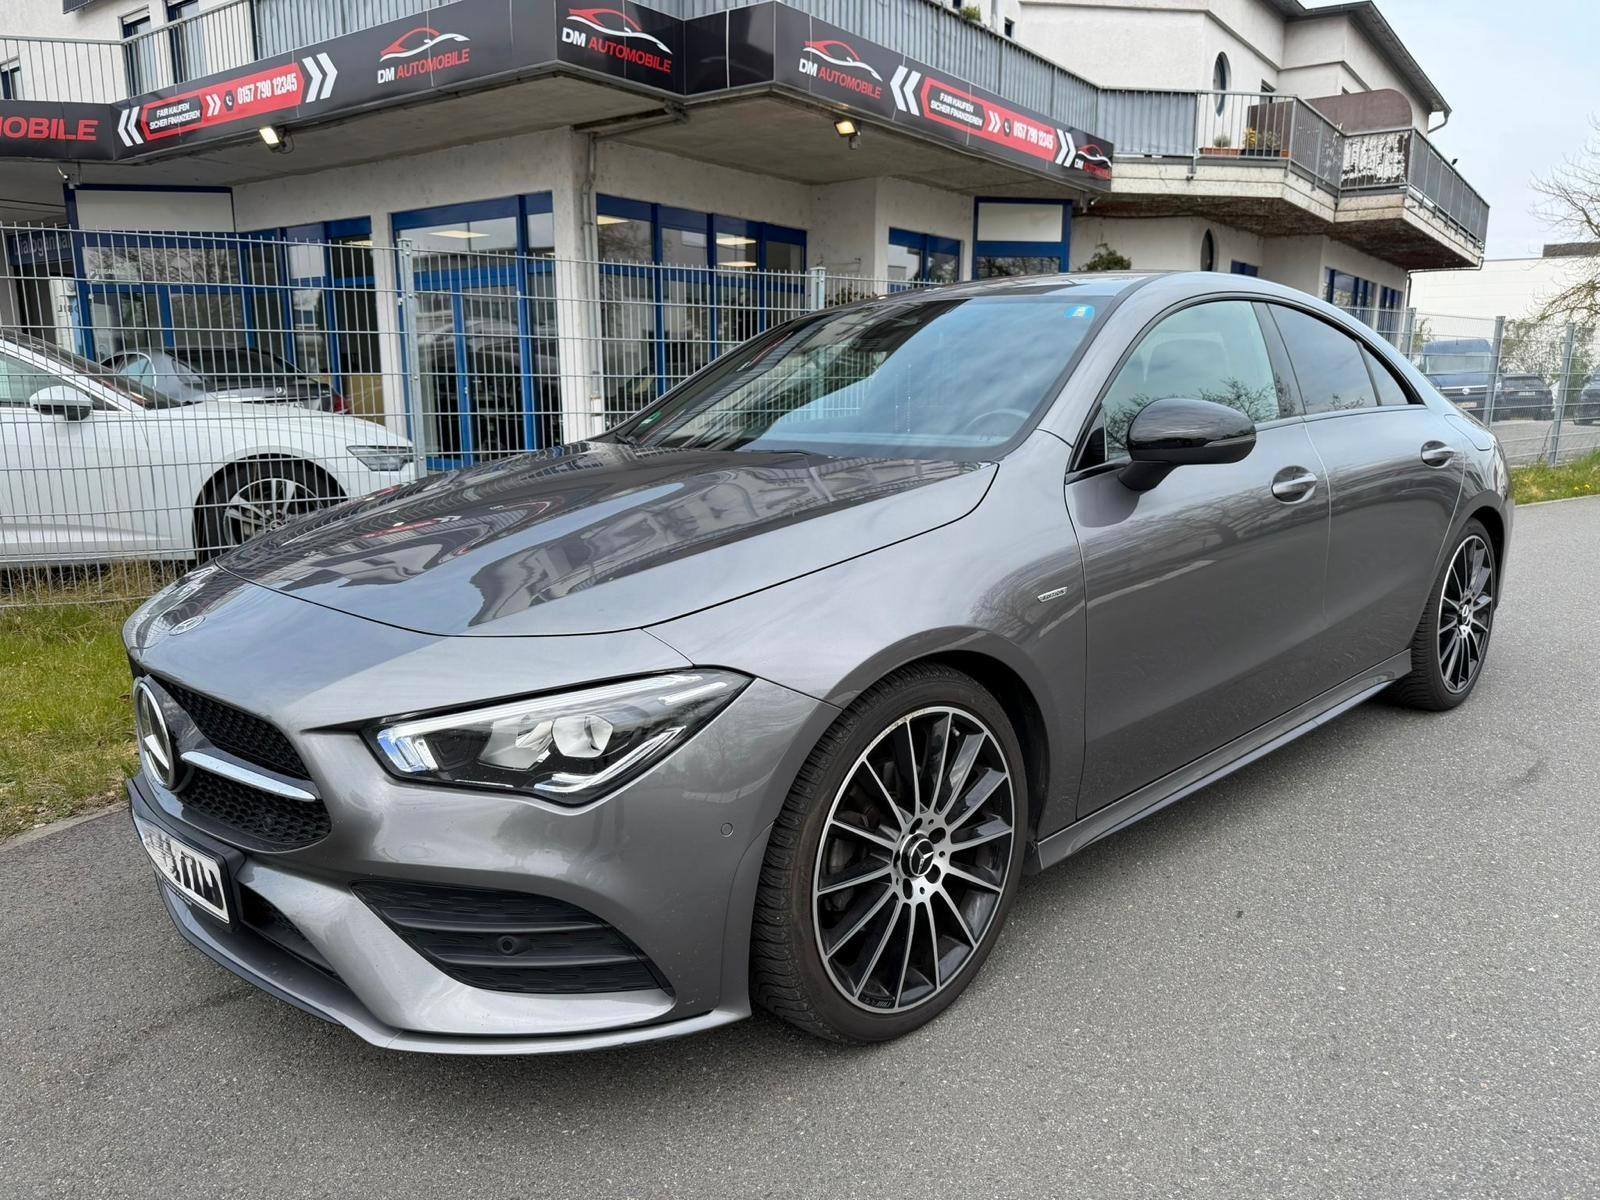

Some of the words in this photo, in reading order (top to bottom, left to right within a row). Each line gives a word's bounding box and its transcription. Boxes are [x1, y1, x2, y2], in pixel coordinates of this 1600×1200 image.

[378, 67, 395, 84] DM
[396, 48, 470, 79] AUTOMOBILE
[562, 27, 586, 47] DM
[588, 36, 672, 73] AUTOMOBILE
[237, 87, 254, 105] 0157
[256, 79, 271, 100] 790
[272, 73, 298, 95] 12345
[799, 58, 818, 77] DM
[818, 66, 882, 99] AUTOMOBILE
[149, 119, 168, 130] SICHER
